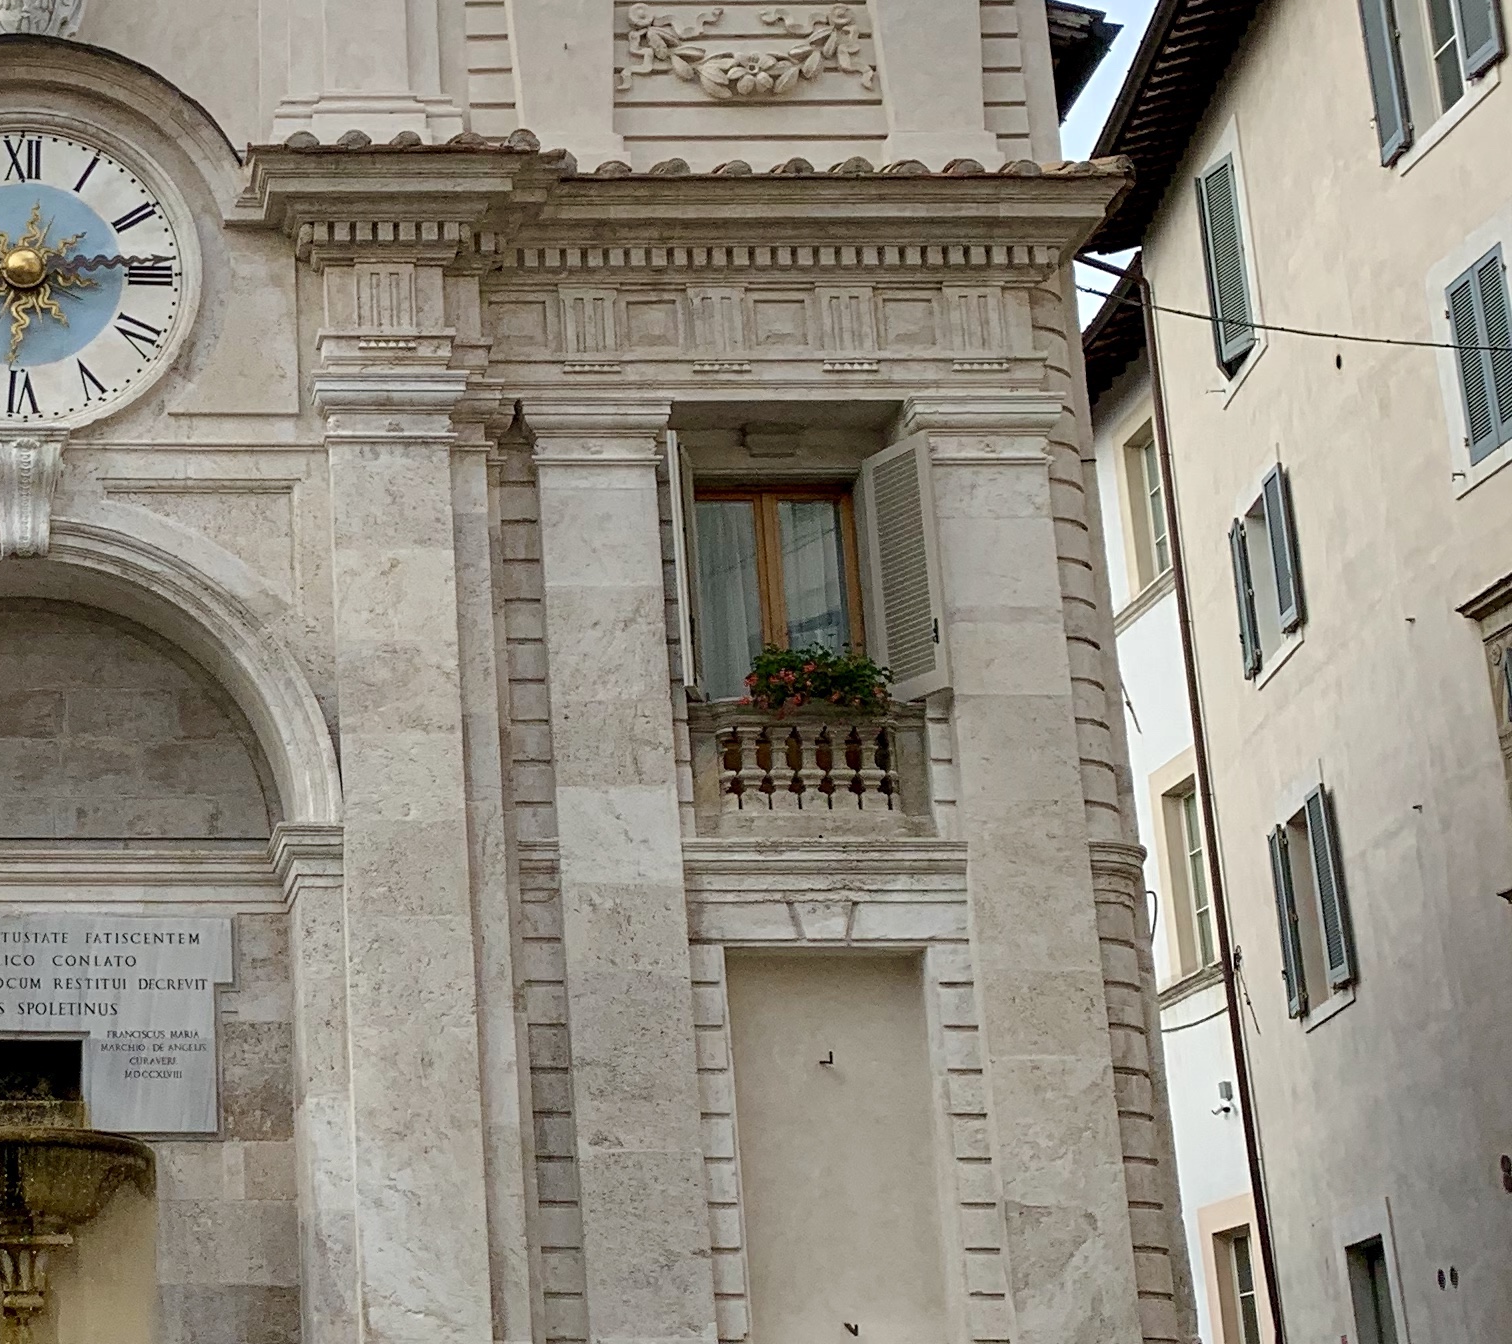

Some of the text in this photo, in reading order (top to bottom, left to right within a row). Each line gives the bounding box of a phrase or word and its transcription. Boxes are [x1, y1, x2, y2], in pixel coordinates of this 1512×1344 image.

[4, 139, 41, 181] XII
[85, 932, 201, 945] FATISCENTEM
[52, 954, 138, 968] CONLATO
[53, 976, 128, 990] RESTITUI
[137, 977, 209, 992] DECREVIT
[17, 1001, 119, 1016] SPOLETINUS
[100, 1043, 146, 1052] MARCHIO
